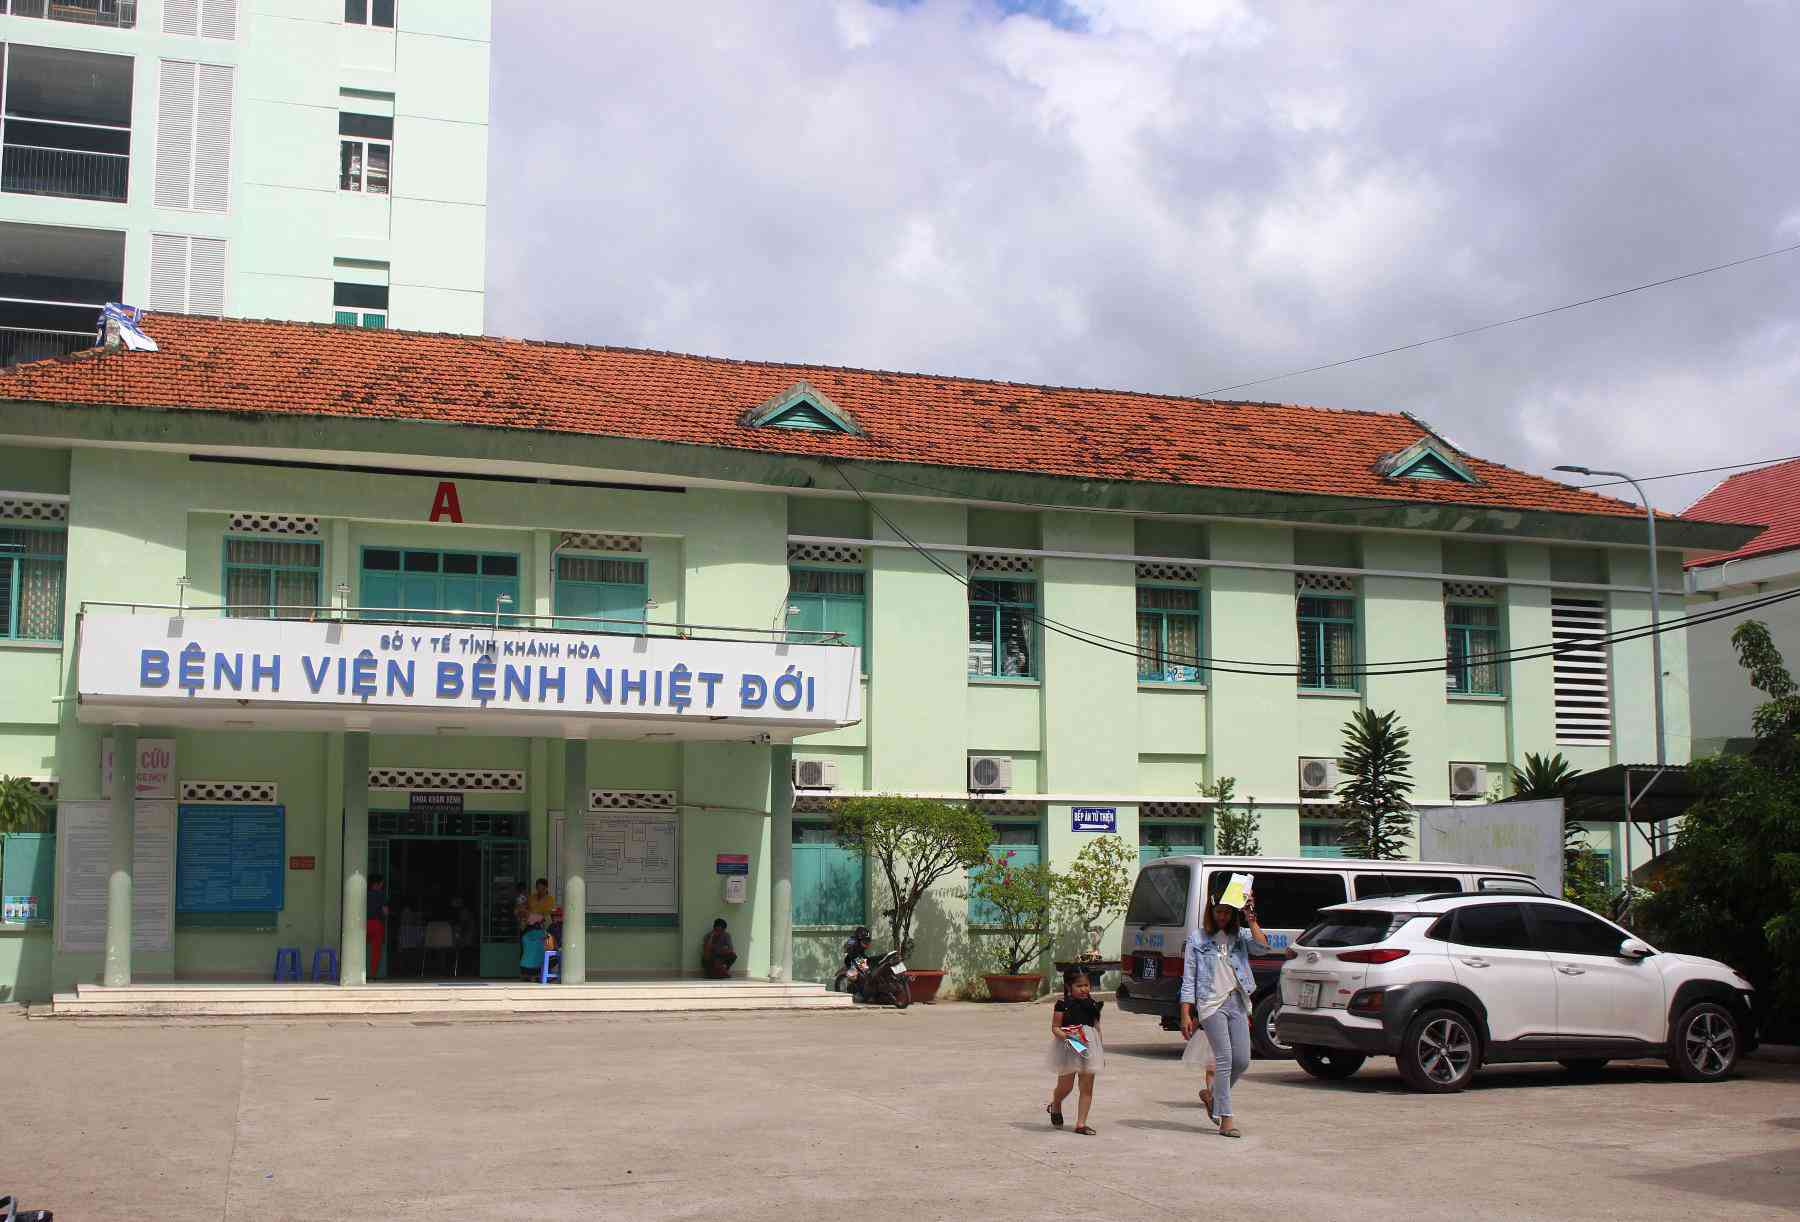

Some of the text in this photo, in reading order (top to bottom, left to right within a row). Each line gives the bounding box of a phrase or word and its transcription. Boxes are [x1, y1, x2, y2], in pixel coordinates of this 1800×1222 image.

[429, 481, 464, 523] A
[380, 630, 601, 660] SỞ Y TẾ TỈNH KHÁNH HÒA
[140, 641, 815, 714] BỆNH VIỆN BỆNH NHIỆT ĐỚI
